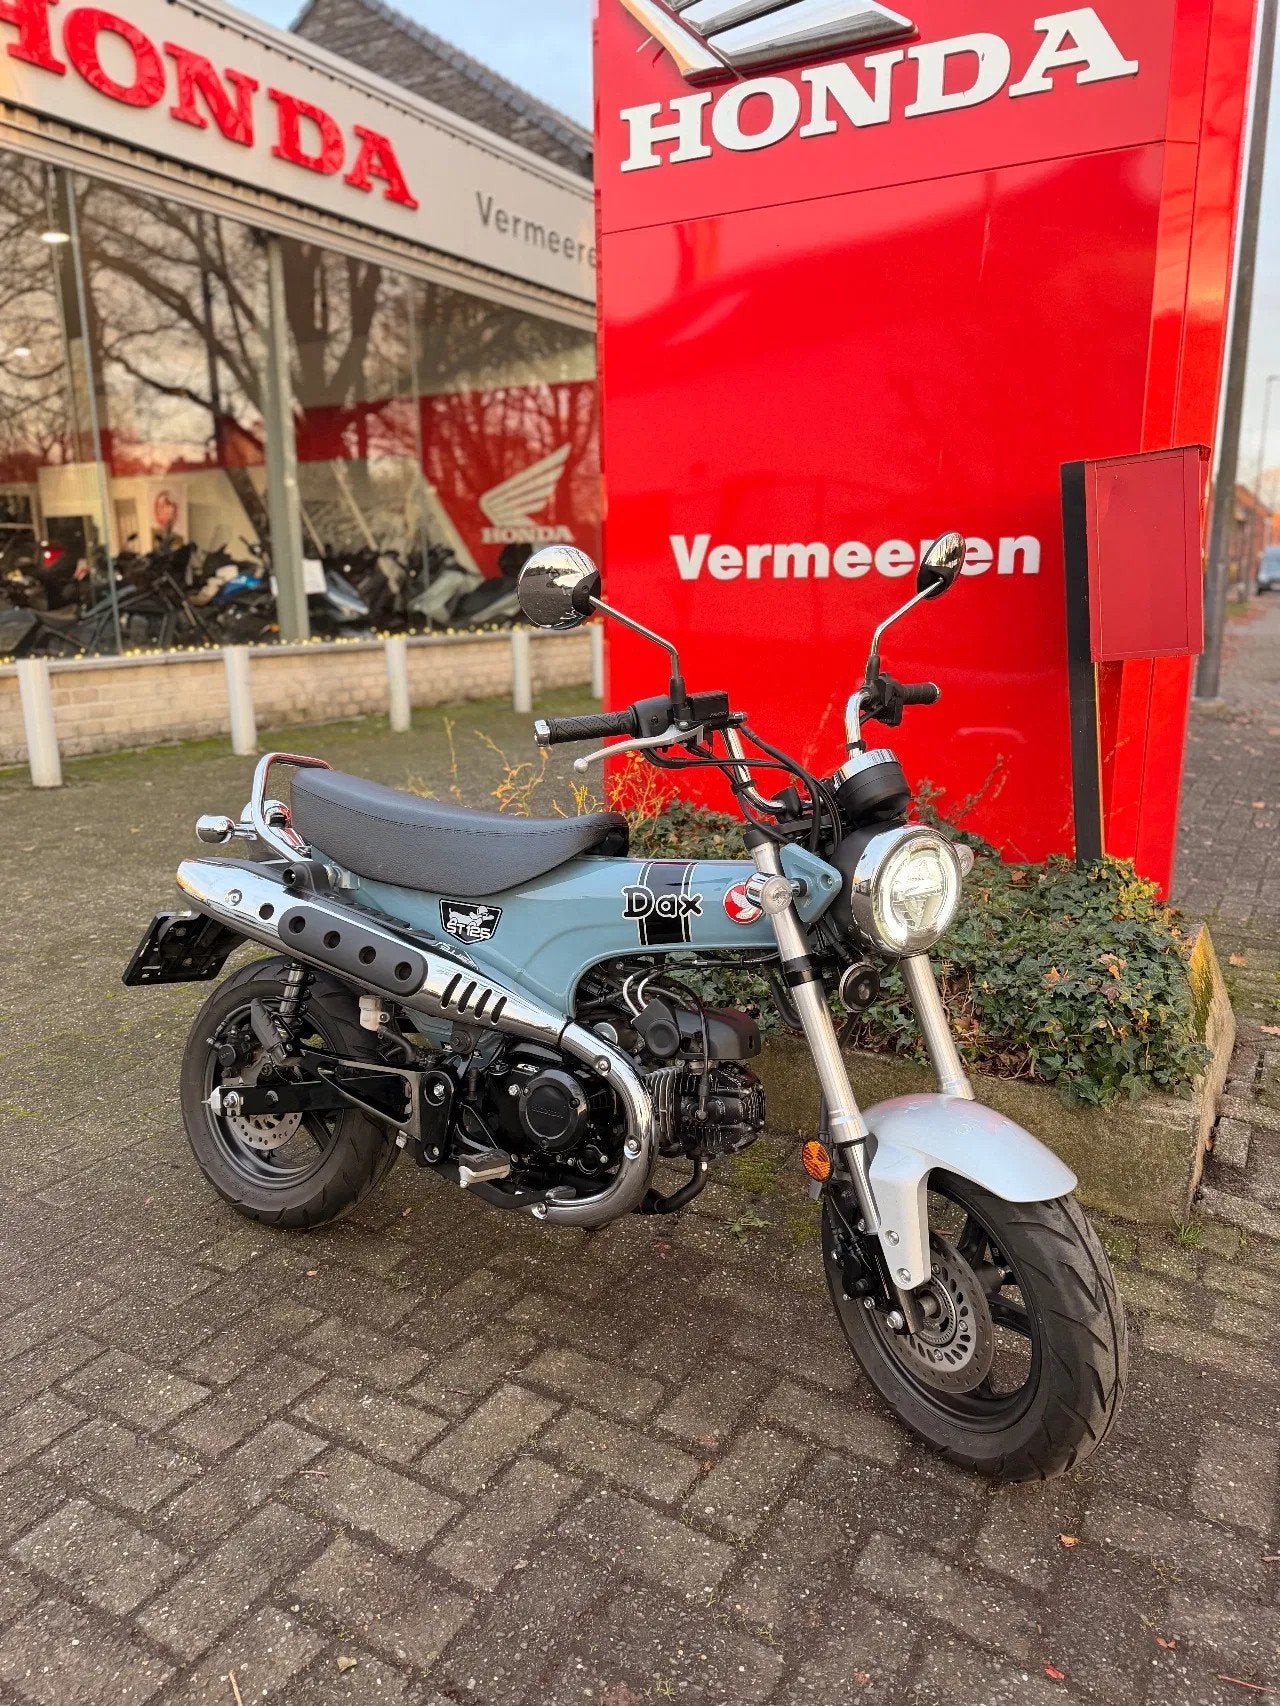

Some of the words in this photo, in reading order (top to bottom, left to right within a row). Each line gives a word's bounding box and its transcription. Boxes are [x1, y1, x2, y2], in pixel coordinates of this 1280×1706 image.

[620, 7, 1139, 172] HONDA
[481, 525, 576, 544] HONDA
[622, 885, 703, 919] Dax
